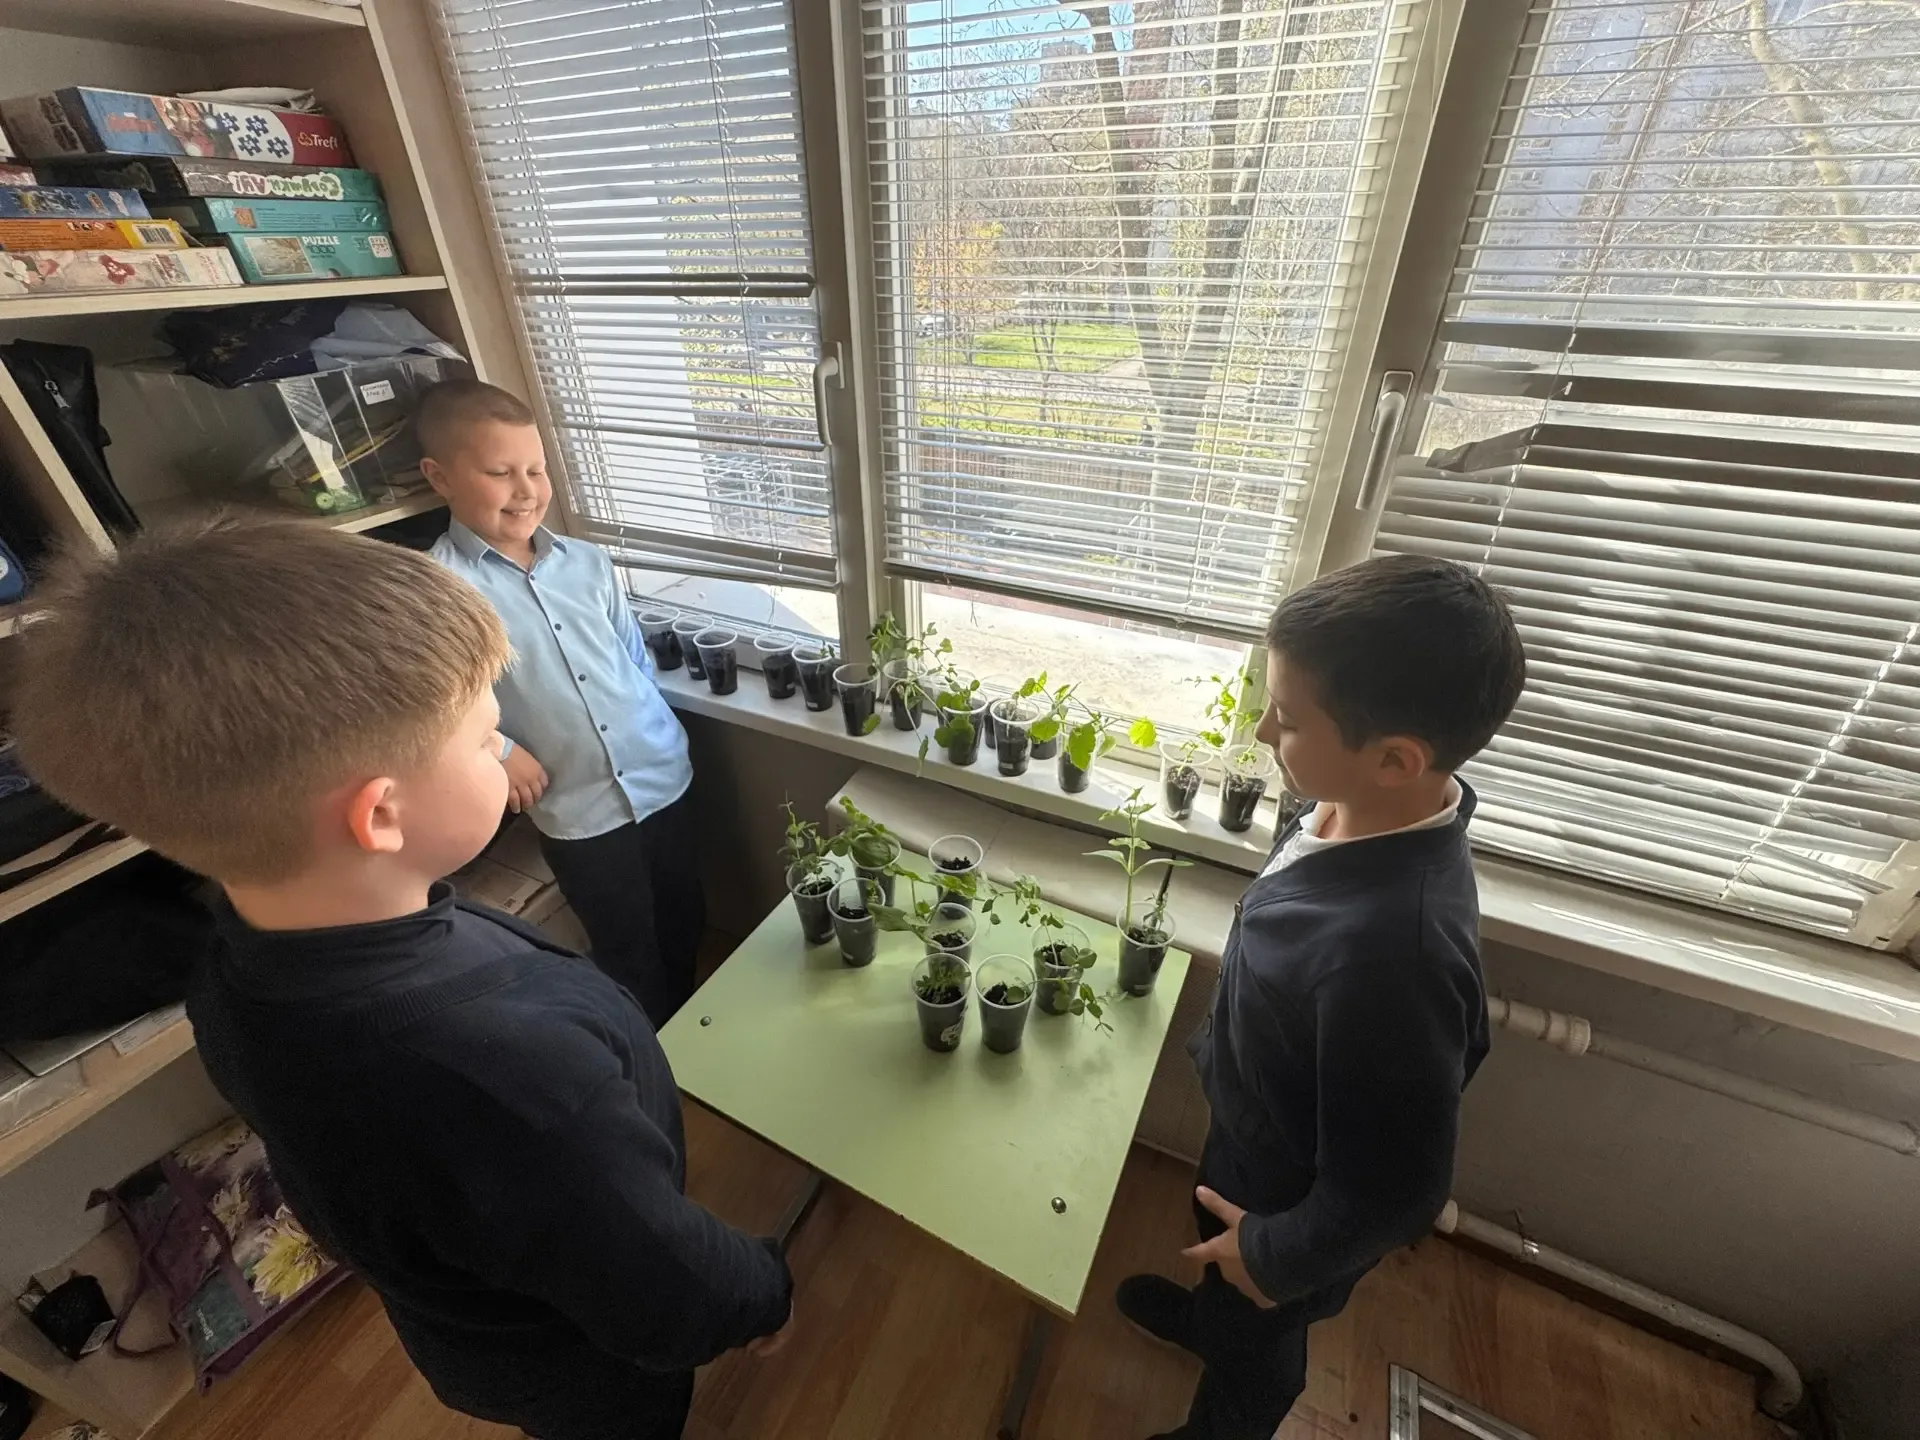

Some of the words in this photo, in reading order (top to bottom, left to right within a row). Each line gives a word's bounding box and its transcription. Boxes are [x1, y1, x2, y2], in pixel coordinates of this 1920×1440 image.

[310, 133, 338, 150] Trefl
[301, 235, 341, 245] PUZZLE
[305, 244, 337, 254] 1000
